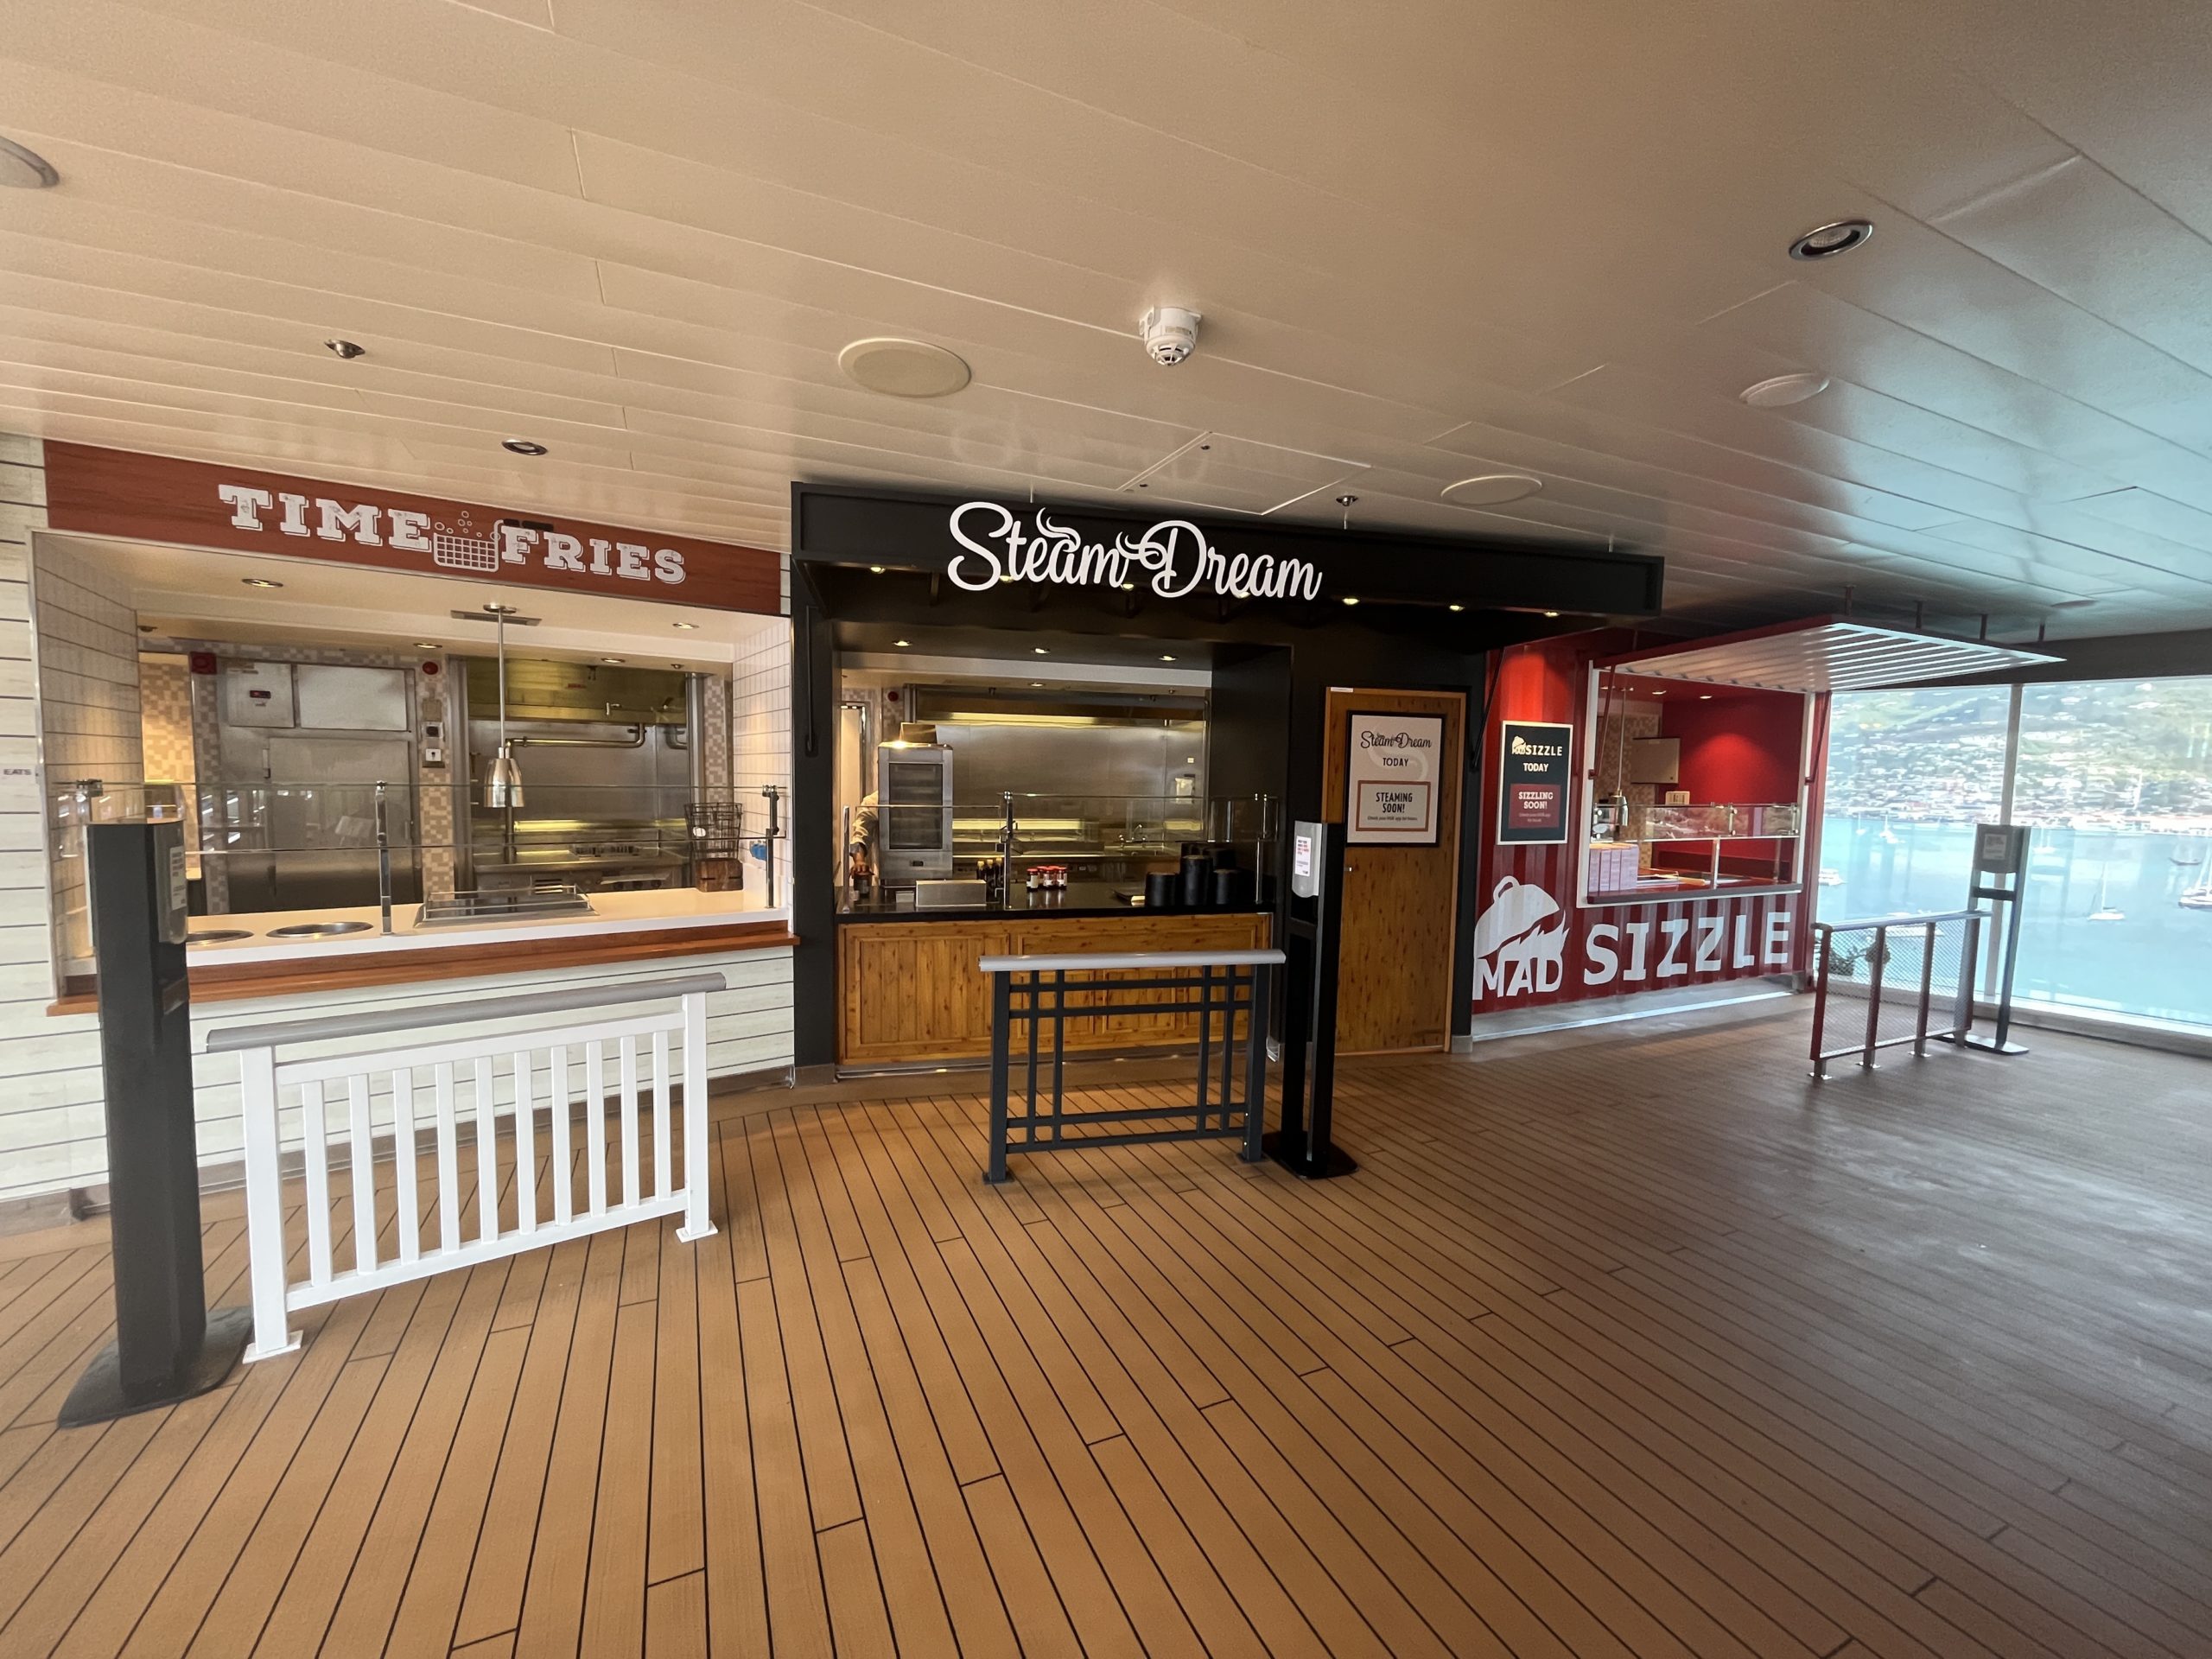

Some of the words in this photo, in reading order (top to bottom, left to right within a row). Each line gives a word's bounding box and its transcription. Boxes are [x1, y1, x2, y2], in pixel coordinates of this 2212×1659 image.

[219, 484, 432, 553] TIME
[500, 525, 686, 583] FRIES
[948, 501, 1128, 591] Steam
[1117, 520, 1322, 601] Dream
[1360, 730, 1394, 749] Steam
[1394, 732, 1432, 749] Dream
[1526, 744, 1563, 756] SIZZLE
[1382, 757, 1408, 767] TODAY
[1522, 762, 1549, 772] TODAY
[1376, 791, 1413, 803] STEAMING
[1518, 791, 1554, 800] SIZZLING
[1382, 803, 1405, 813] SOON!
[1523, 801, 1548, 810] SOON!
[1472, 957, 1563, 1001] MAD
[1584, 912, 1791, 986] SIZZLE
